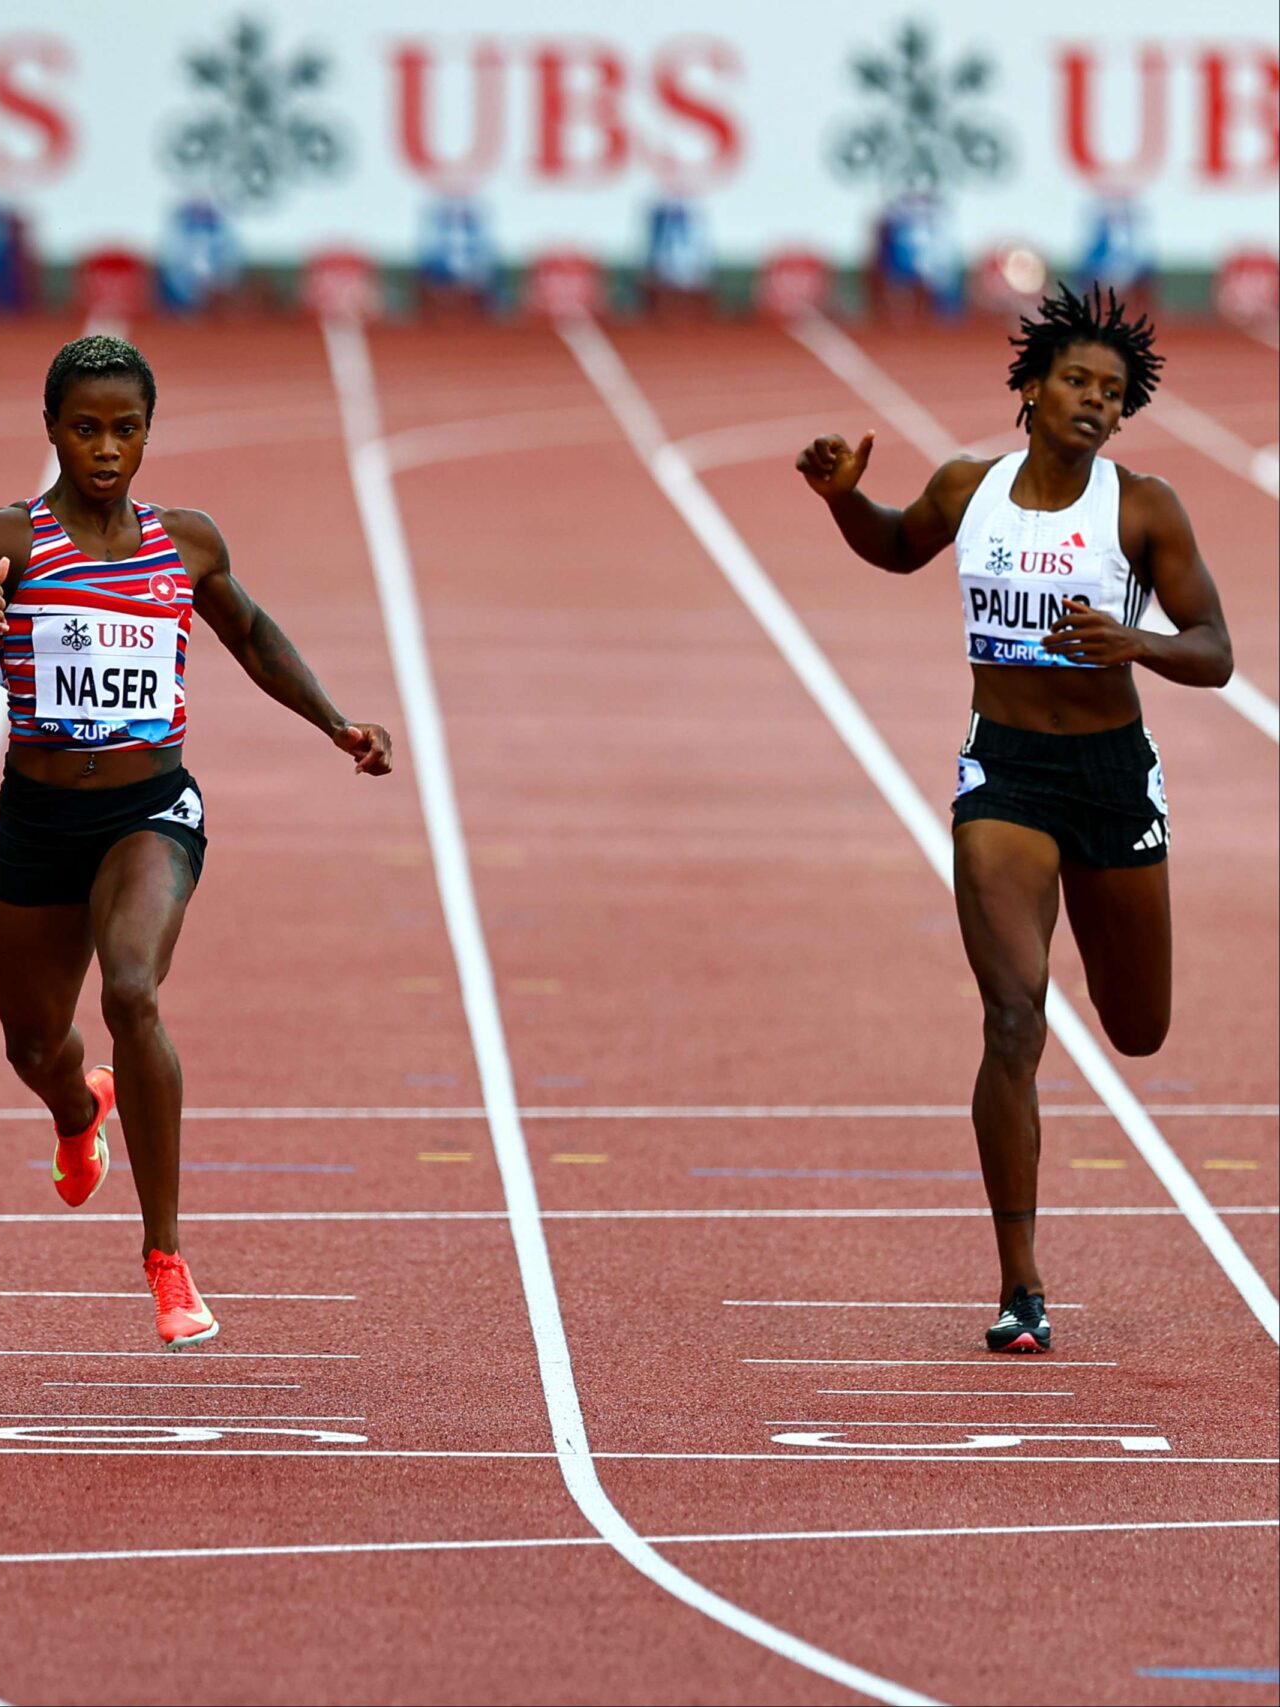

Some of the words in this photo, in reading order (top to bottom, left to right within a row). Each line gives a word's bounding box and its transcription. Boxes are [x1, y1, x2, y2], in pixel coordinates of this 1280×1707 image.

[391, 41, 745, 190] UBS
[1019, 551, 1075, 576] UBS
[96, 623, 155, 650] UBS
[993, 643, 1059, 661] ZURIC
[55, 665, 158, 709] NASER
